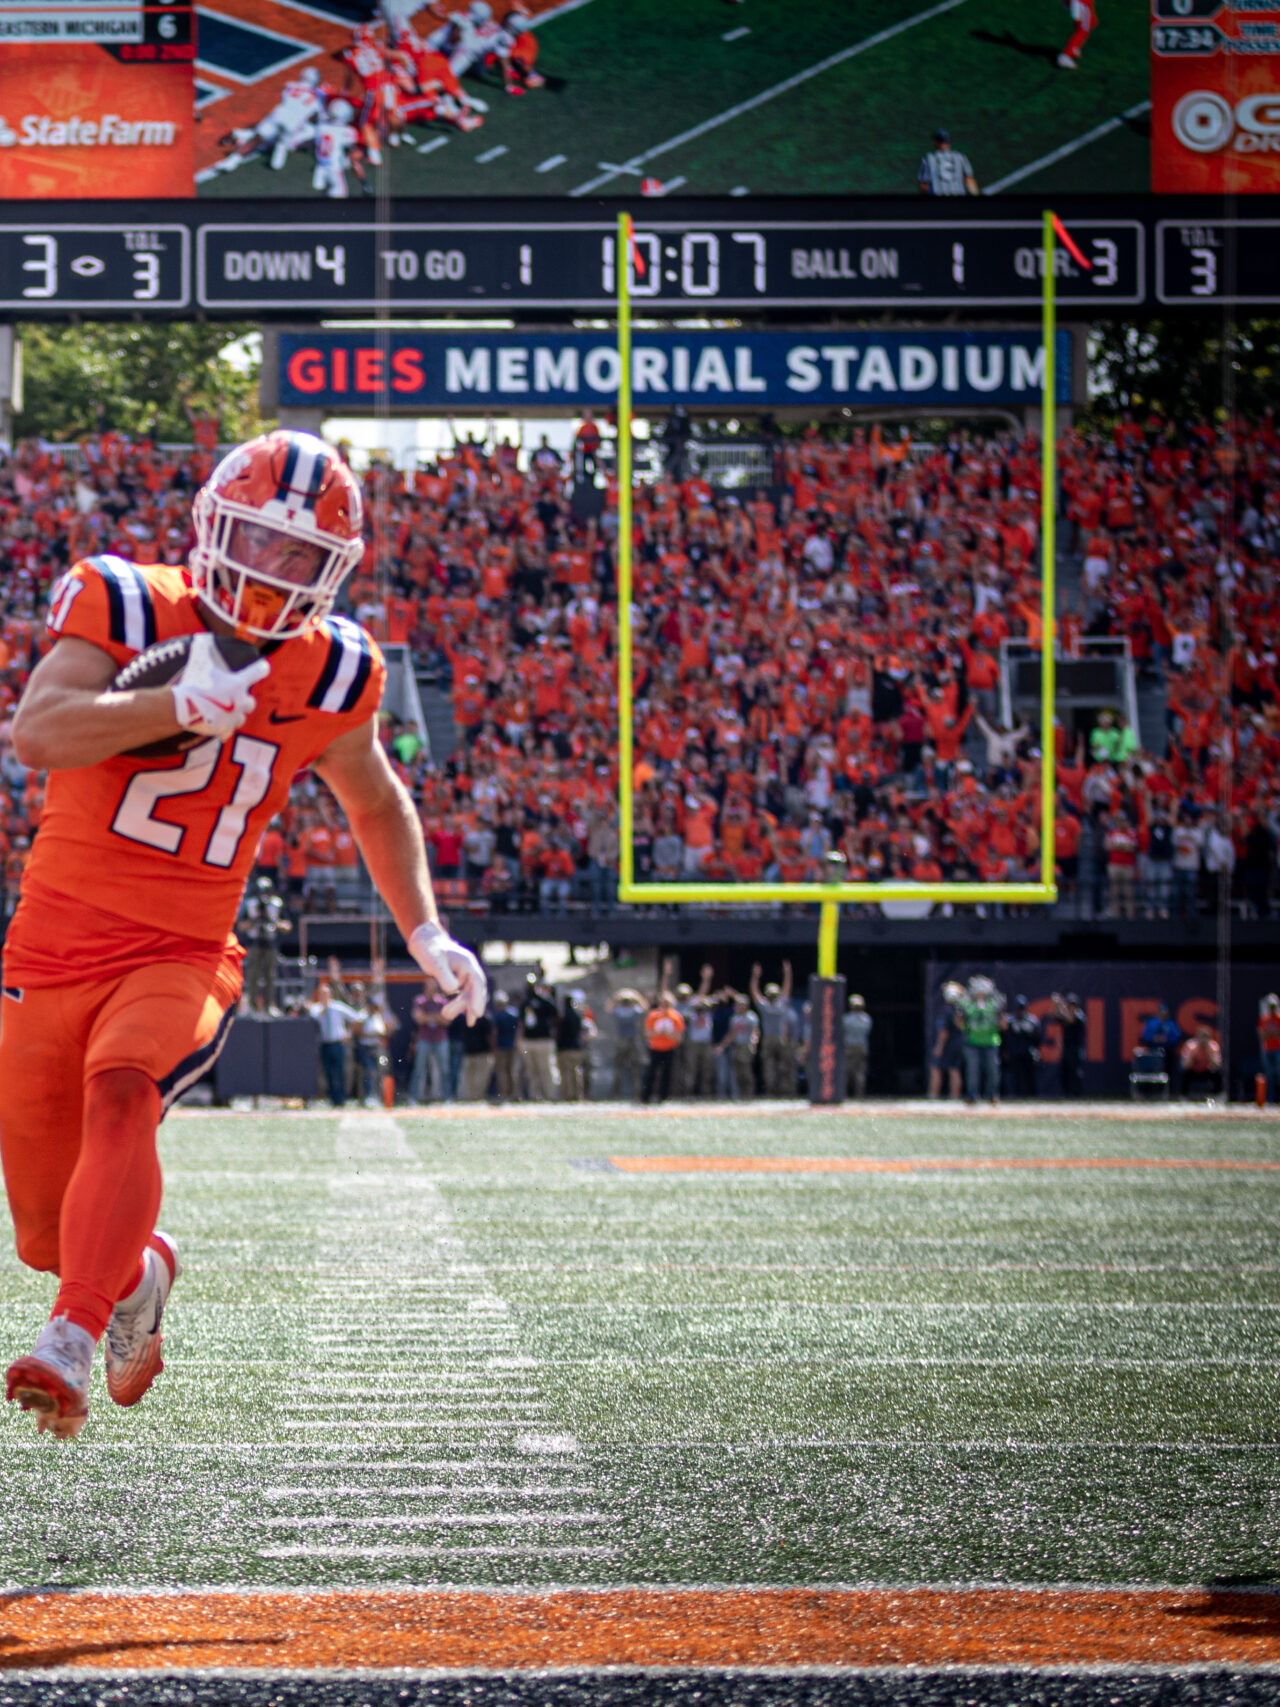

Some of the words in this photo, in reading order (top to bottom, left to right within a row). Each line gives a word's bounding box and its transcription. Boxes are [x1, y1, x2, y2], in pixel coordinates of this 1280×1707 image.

[65, 21, 138, 35] MICHIGAN
[157, 14, 177, 38] 6
[22, 234, 57, 298] 3
[132, 252, 159, 299] 3
[224, 250, 312, 281] DOWN
[315, 244, 345, 286] 4
[380, 250, 418, 281] TO
[424, 250, 466, 281] GO
[520, 244, 532, 286] 1
[602, 232, 767, 296] 10:07
[791, 248, 856, 279] BALL
[860, 248, 899, 279] ON
[952, 241, 964, 285] 1
[1091, 238, 1118, 286] 3
[1190, 248, 1217, 296] 3
[287, 347, 427, 394] GIES
[445, 346, 767, 393] MEMORIAL
[786, 345, 1046, 392] STADIUM
[109, 732, 281, 870] 21
